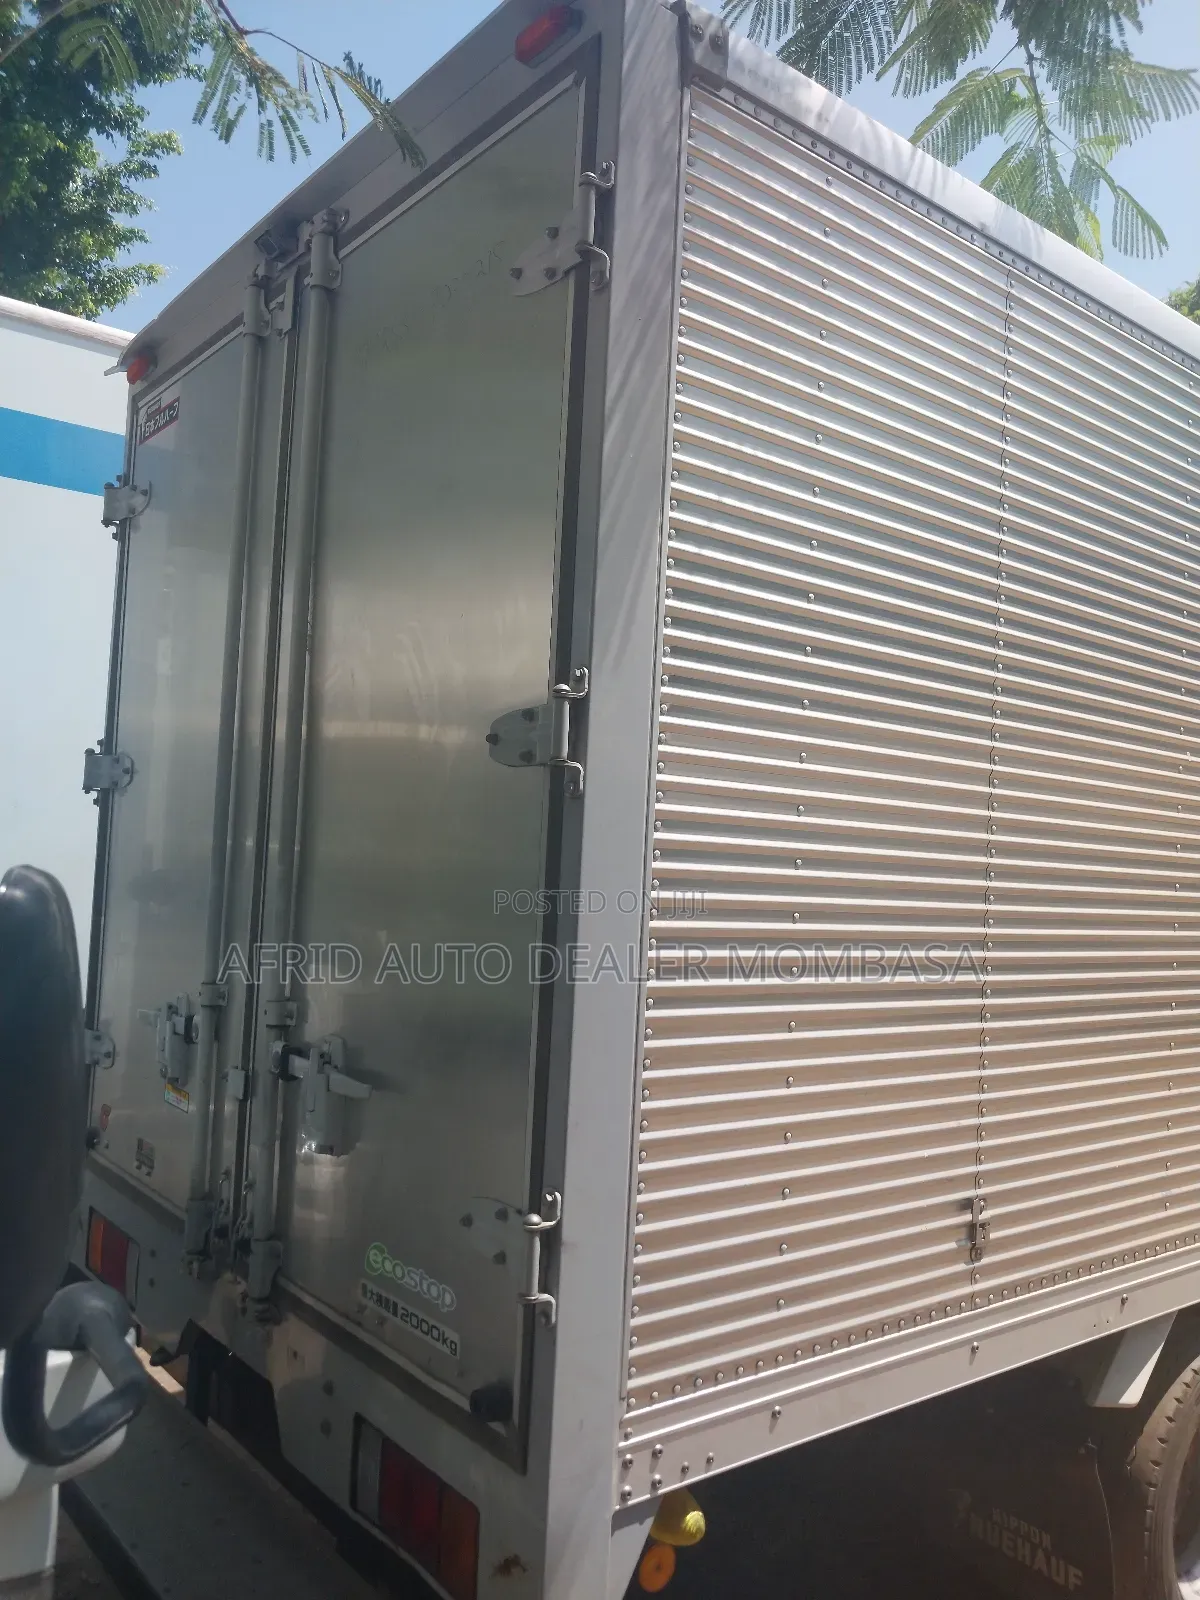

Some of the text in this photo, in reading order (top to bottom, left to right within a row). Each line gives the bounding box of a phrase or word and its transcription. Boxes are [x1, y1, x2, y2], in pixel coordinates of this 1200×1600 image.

[145, 402, 179, 437] 日本フルハーフ
[364, 1241, 457, 1313] ecostop
[991, 1506, 1053, 1551] NIPPON
